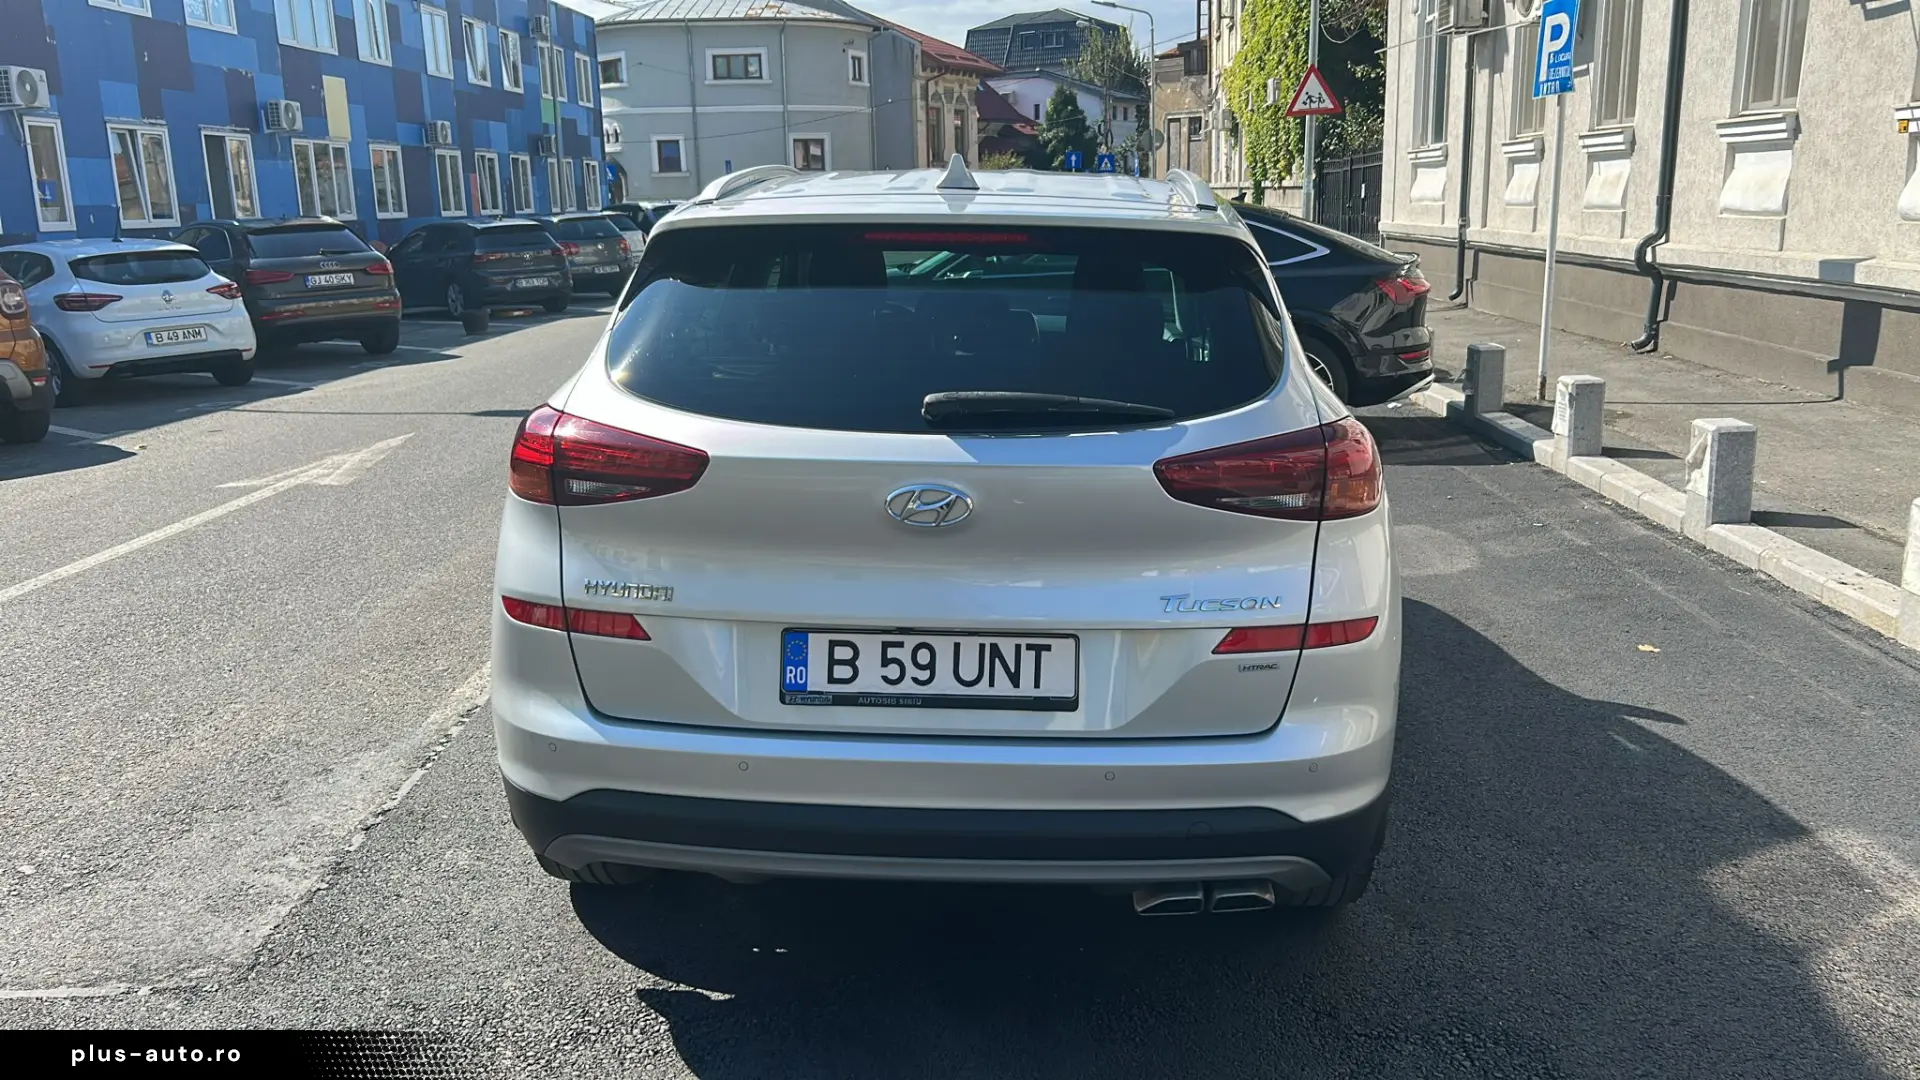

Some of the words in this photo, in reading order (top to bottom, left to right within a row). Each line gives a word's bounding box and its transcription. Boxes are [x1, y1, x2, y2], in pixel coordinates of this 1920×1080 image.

[1539, 12, 1570, 82] P
[155, 332, 164, 343] B
[167, 332, 180, 342] 49
[182, 328, 202, 340] ANM
[584, 578, 674, 602] HYUNDAI
[785, 666, 807, 684] RO
[827, 639, 860, 685] B
[880, 640, 937, 687] 59
[953, 642, 1053, 689] UNT
